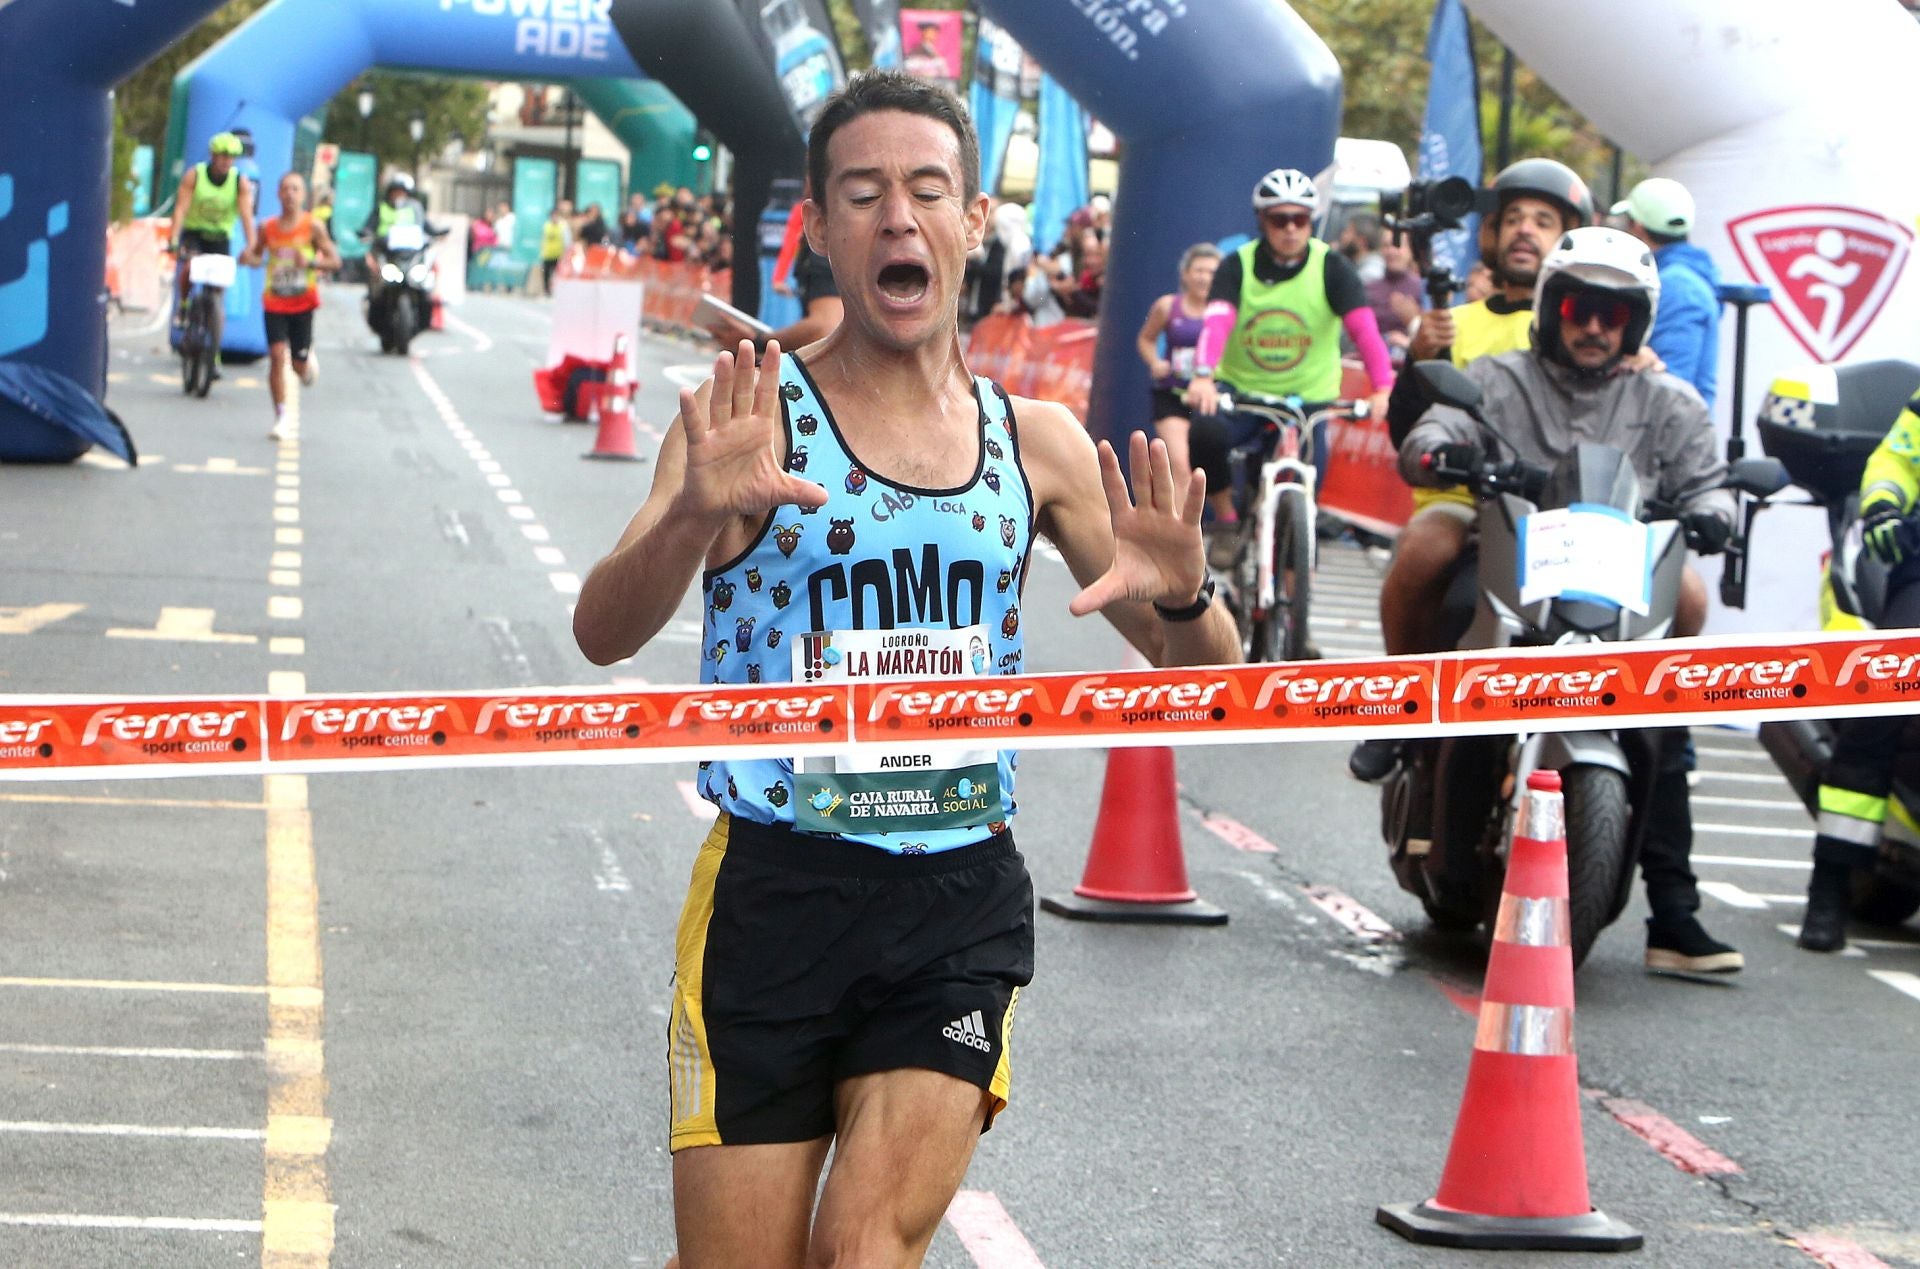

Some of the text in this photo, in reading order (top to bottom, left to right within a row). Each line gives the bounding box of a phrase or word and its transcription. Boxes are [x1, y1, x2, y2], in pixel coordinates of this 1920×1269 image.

[515, 17, 611, 60] ADE
[871, 488, 921, 522] CAB
[933, 499, 967, 515] LOCA
[807, 543, 984, 632] COMO
[882, 633, 929, 648] LOGROÑO
[998, 648, 1022, 668] COMO
[847, 646, 963, 677] LA MARATÓN
[1643, 653, 1811, 696] Ferrer
[1834, 643, 1920, 687] Fer
[1060, 676, 1228, 716] Ferrer
[1254, 668, 1421, 711] Ferrer
[1452, 663, 1619, 704] Ferrer
[474, 697, 641, 735] Ferrer
[668, 692, 835, 728] Ferrer
[867, 684, 1034, 722] Ferrer
[81, 706, 248, 747] Ferrer
[280, 701, 447, 742] Ferrer
[880, 754, 932, 768] ANDER
[850, 789, 935, 805] CAJA RURAL
[943, 781, 987, 799] ACÓN
[943, 798, 988, 813] SOCIAL
[850, 802, 939, 818] DE NAVARRA
[942, 1025, 991, 1053] adidas
